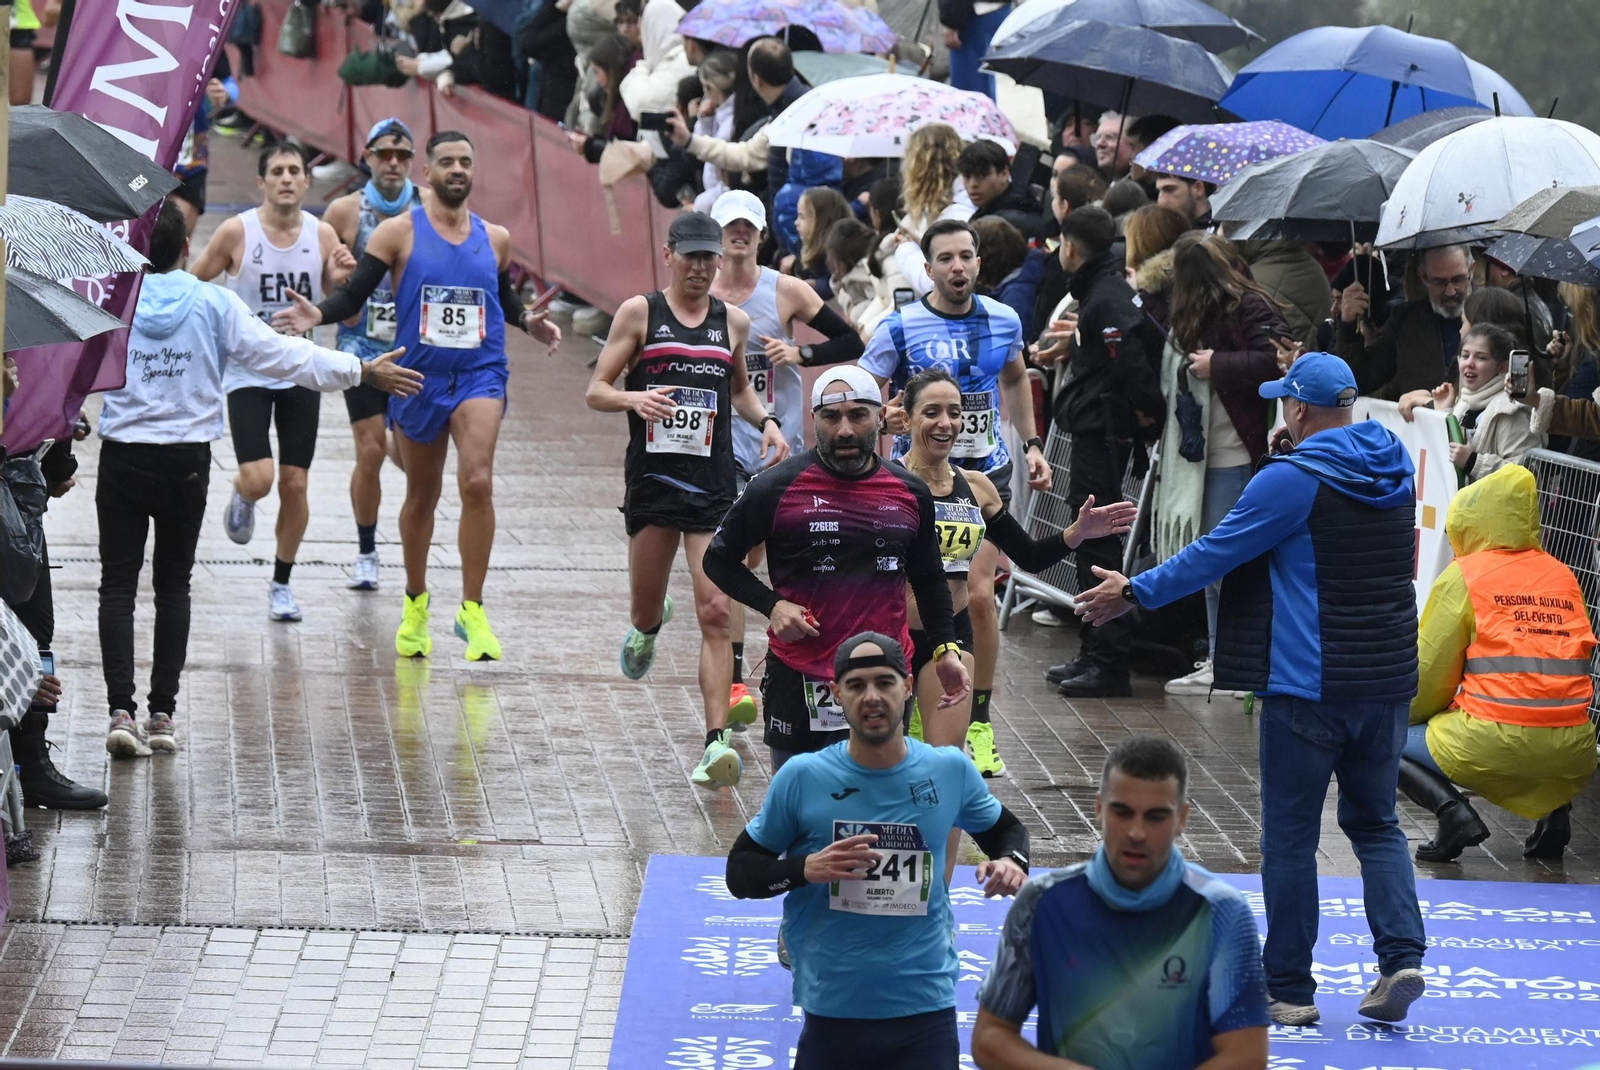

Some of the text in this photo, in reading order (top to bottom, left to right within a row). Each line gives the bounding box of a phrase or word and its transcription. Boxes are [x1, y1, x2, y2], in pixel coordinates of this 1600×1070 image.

[259, 272, 312, 302] ENA
[442, 306, 466, 326] 85
[129, 347, 193, 366] Pepe Yepes
[141, 364, 186, 384] Speaker
[808, 521, 839, 533] 226ERS
[829, 538, 841, 546] up
[1494, 595, 1575, 612] PERSONAL AUXILIAR
[1514, 610, 1563, 625] DEL EVENTO
[881, 825, 914, 836] MEDIA
[866, 888, 895, 896] ALBERTO
[1346, 1032, 1393, 1042] DE
